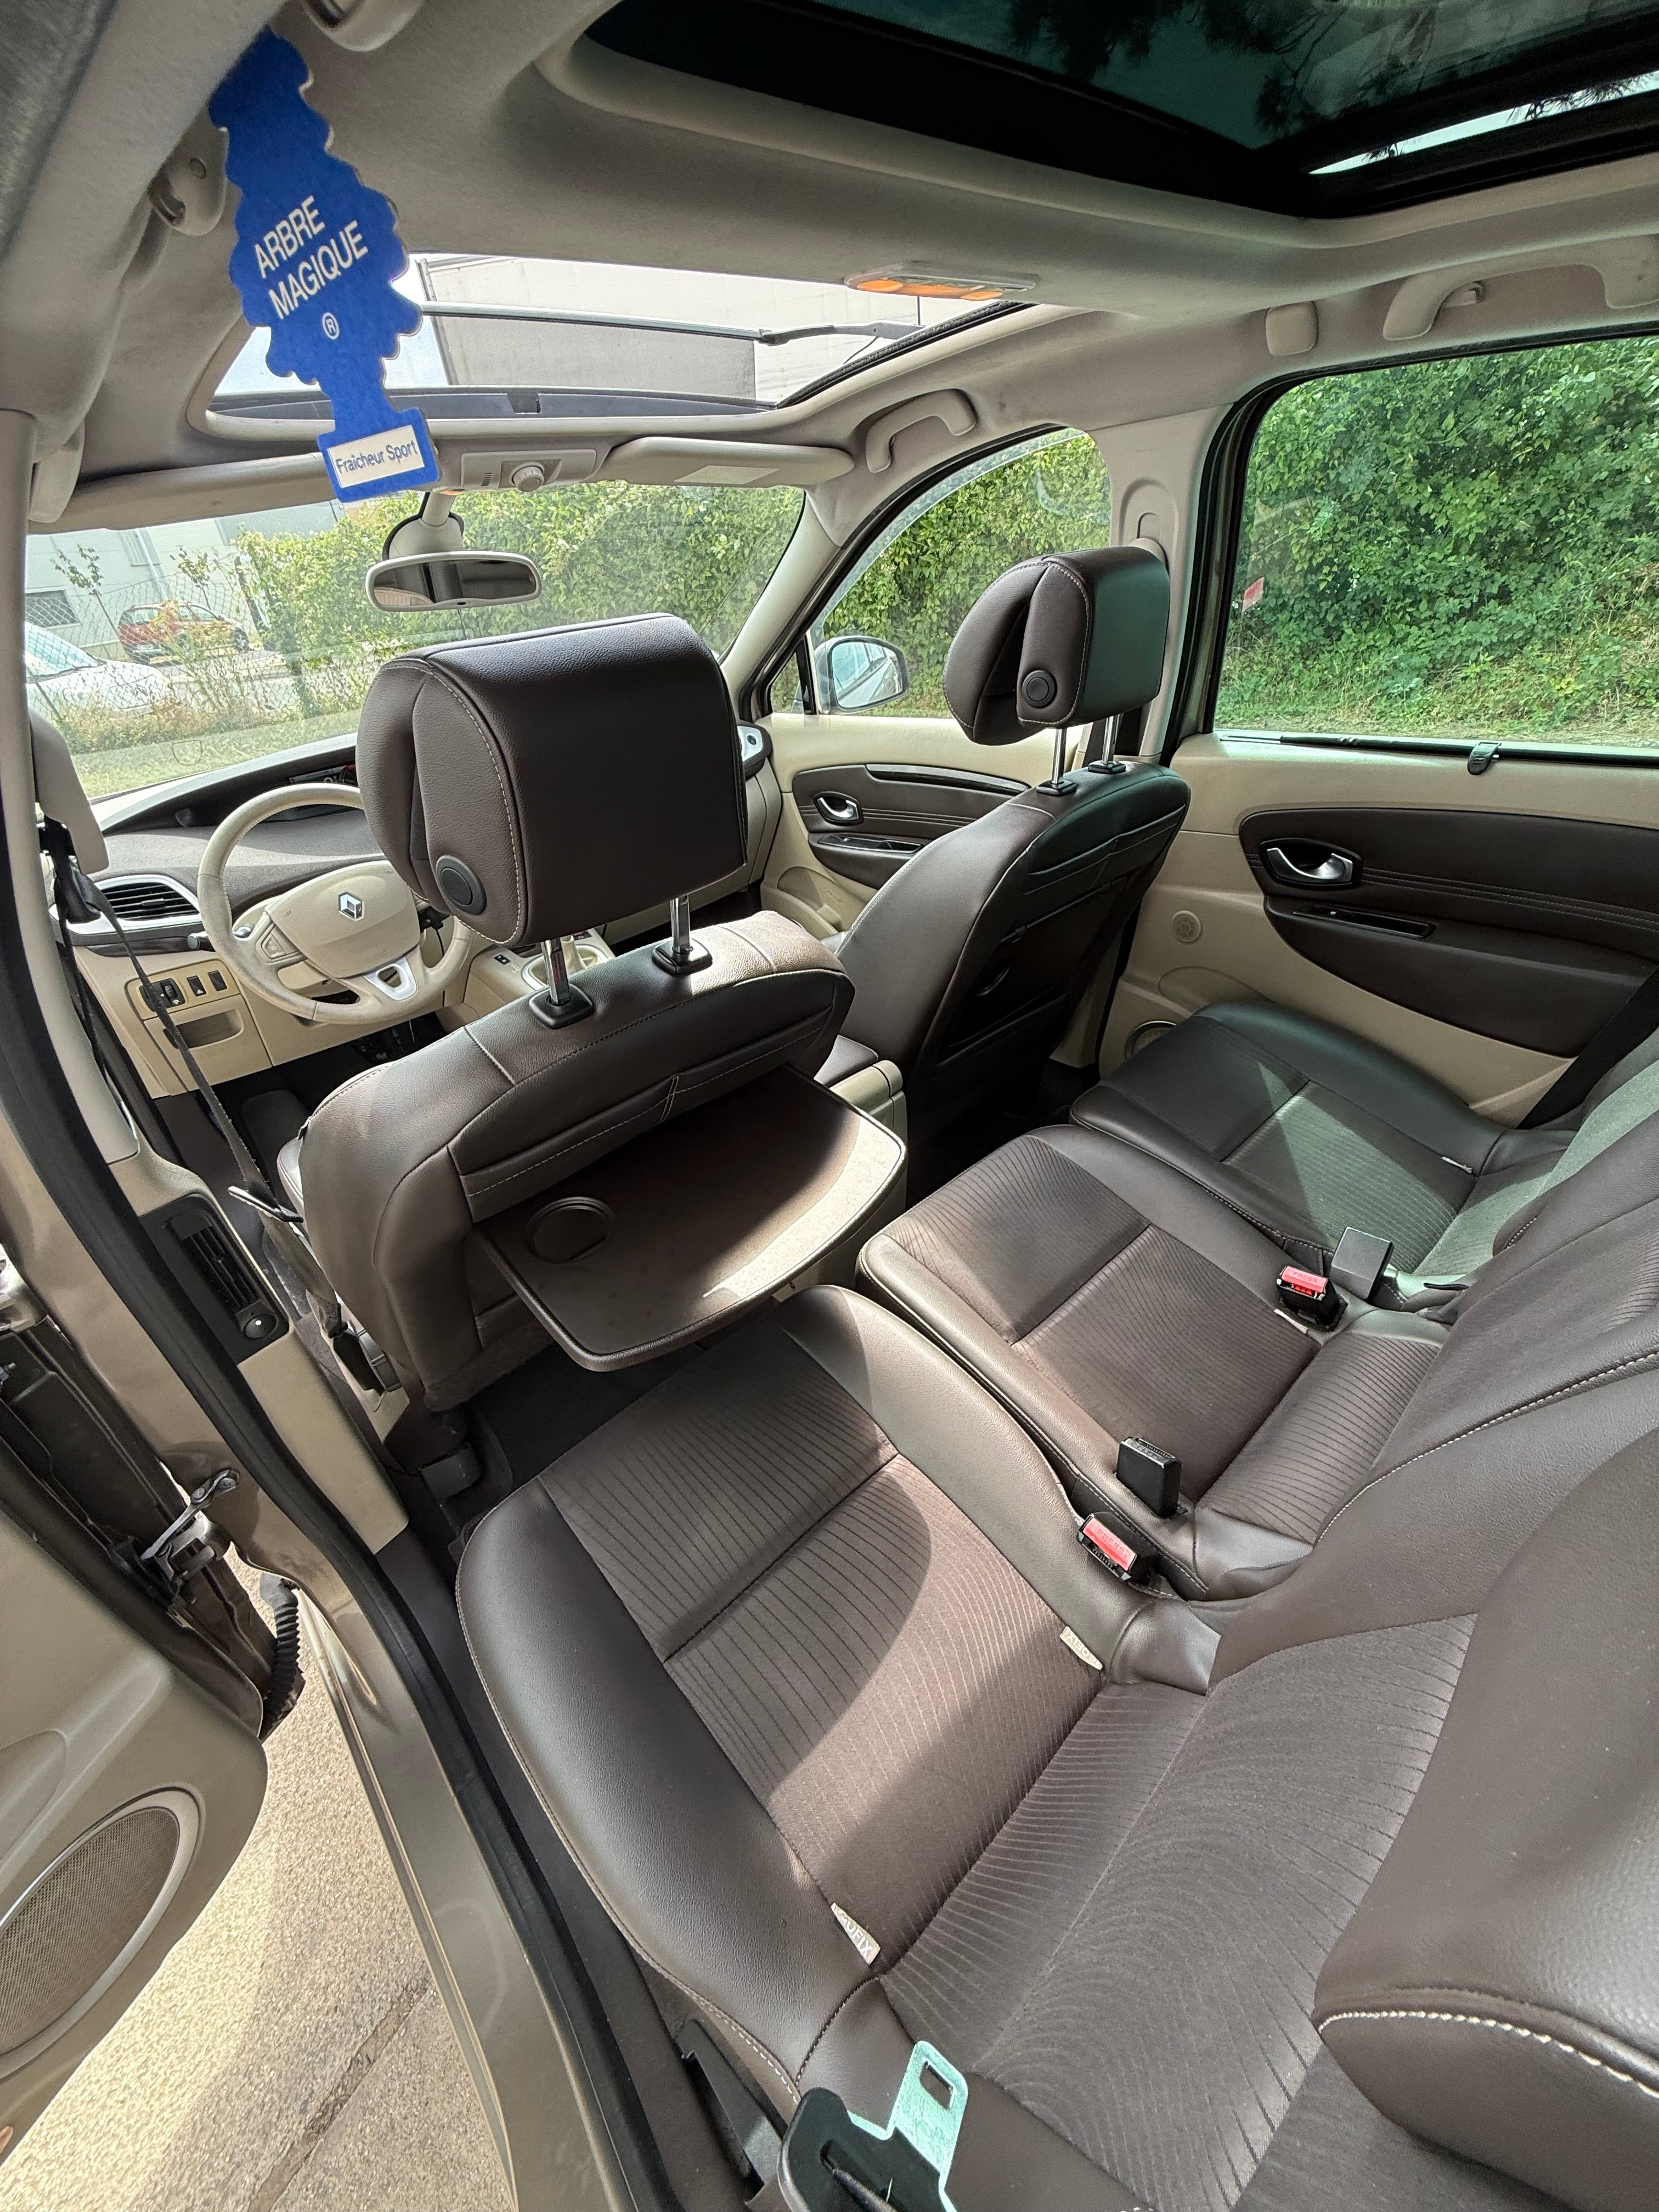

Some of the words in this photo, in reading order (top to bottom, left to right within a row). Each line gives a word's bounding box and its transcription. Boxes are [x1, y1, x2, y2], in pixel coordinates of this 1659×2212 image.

[254, 195, 325, 279] ARBRE
[268, 220, 369, 320] MAGIQUE
[386, 439, 418, 464] Sport
[1293, 1271, 1318, 1283] PRESS
[1066, 1630, 1099, 1667] ISOFIX
